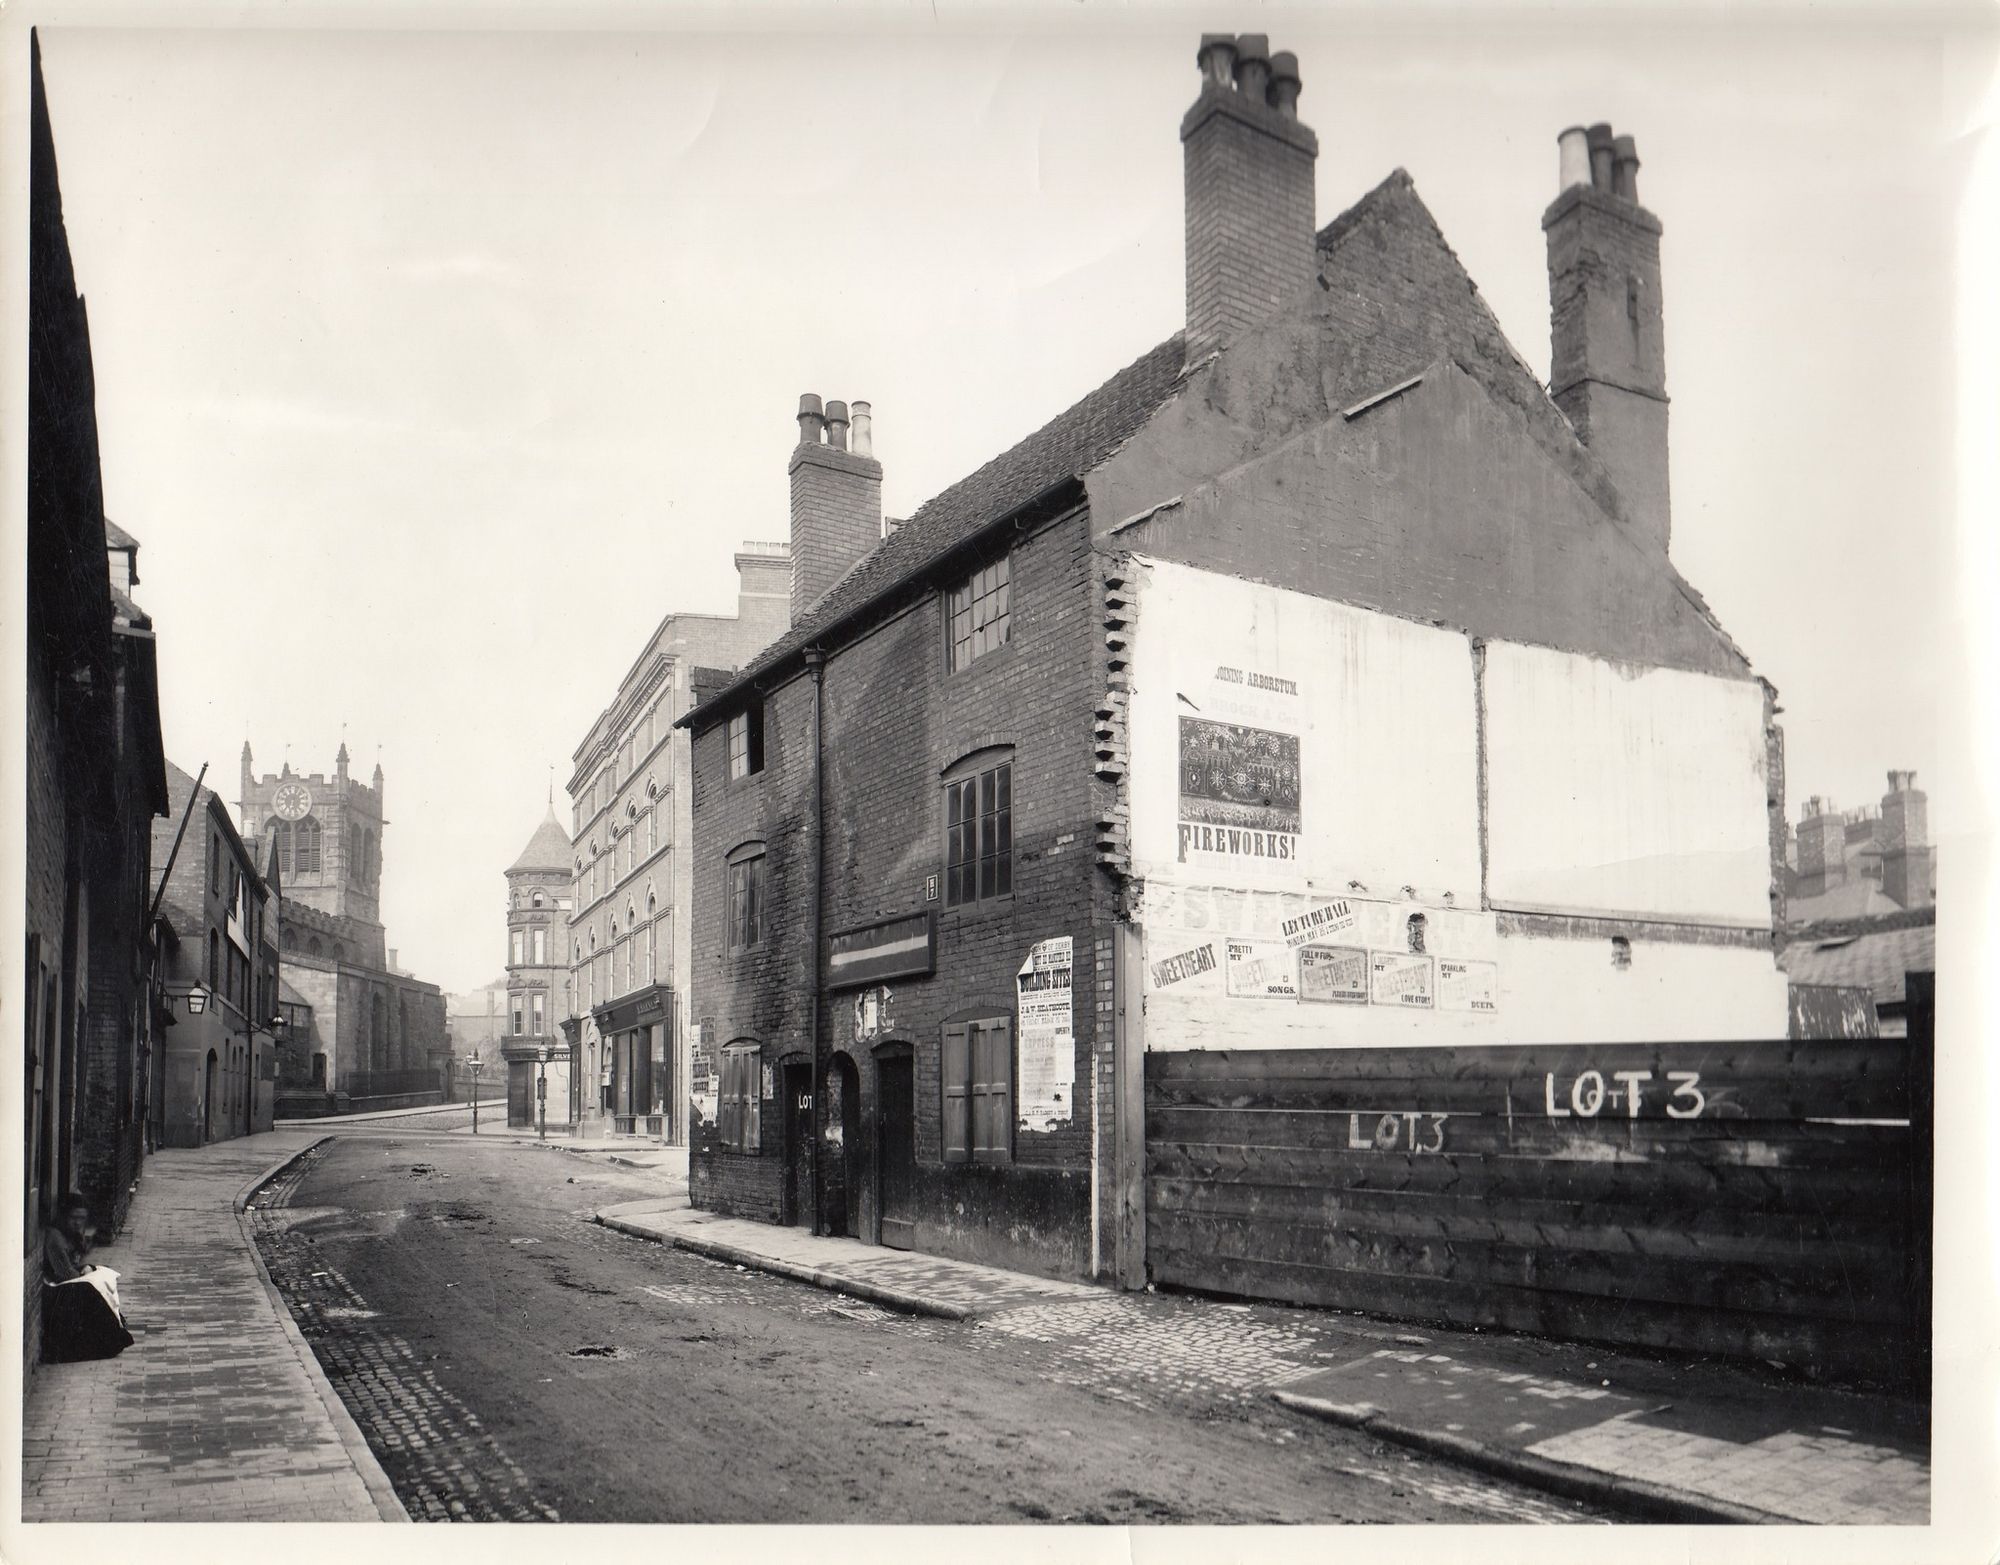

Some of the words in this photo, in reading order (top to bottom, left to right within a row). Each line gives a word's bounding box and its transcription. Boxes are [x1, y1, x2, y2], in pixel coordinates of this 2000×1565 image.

[1177, 823, 1297, 863] FIREWORKS!
[1282, 909, 1326, 936] LECTURE
[1324, 901, 1351, 921] HALL
[1228, 944, 1253, 954] PRETTY
[1150, 943, 1217, 988] SWEETHEART
[1374, 964, 1385, 972] MY
[1440, 964, 1467, 973] SPARKLING
[1052, 967, 1071, 989] SITES
[1267, 985, 1296, 994] SONGS.
[1401, 994, 1414, 1004] LOVE
[798, 1094, 813, 1110] LOT
[1545, 1069, 1652, 1119] LOT
[1666, 1071, 1705, 1119] 3
